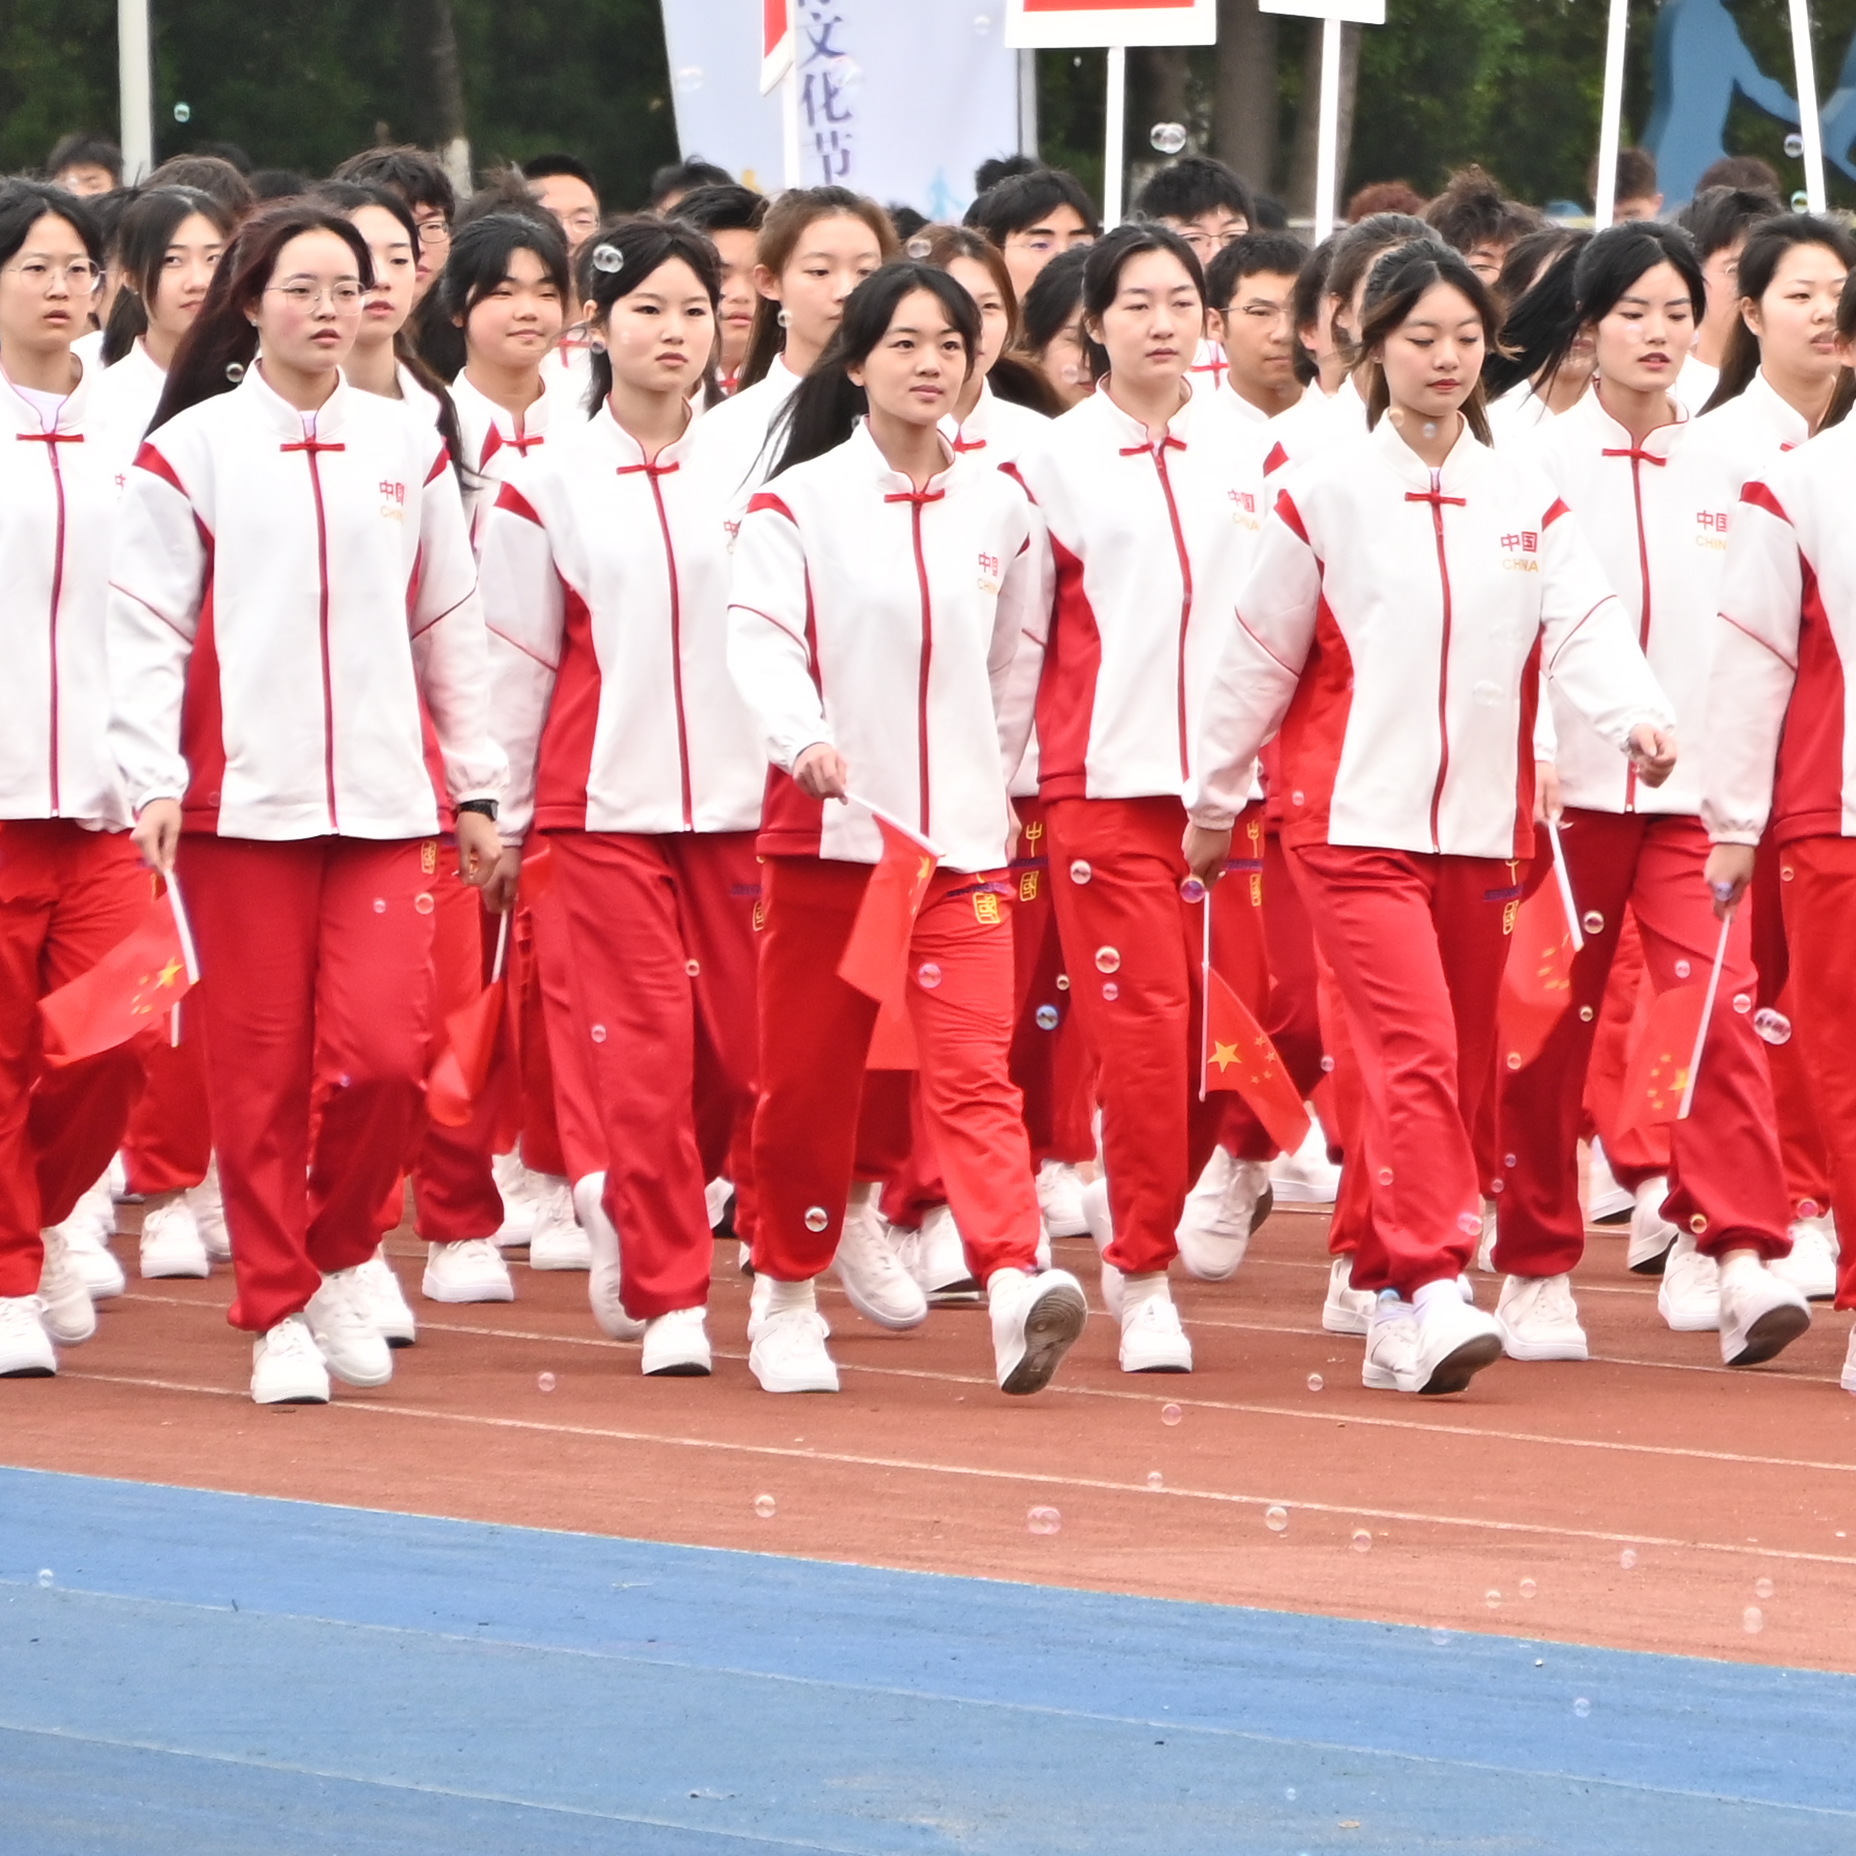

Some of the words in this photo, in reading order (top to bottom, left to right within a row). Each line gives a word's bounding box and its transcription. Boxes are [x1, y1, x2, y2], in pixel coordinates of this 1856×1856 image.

[1500, 530, 1538, 553] 中国
[1695, 535, 1729, 551] CHIN
[1502, 558, 1540, 573] CHINA
